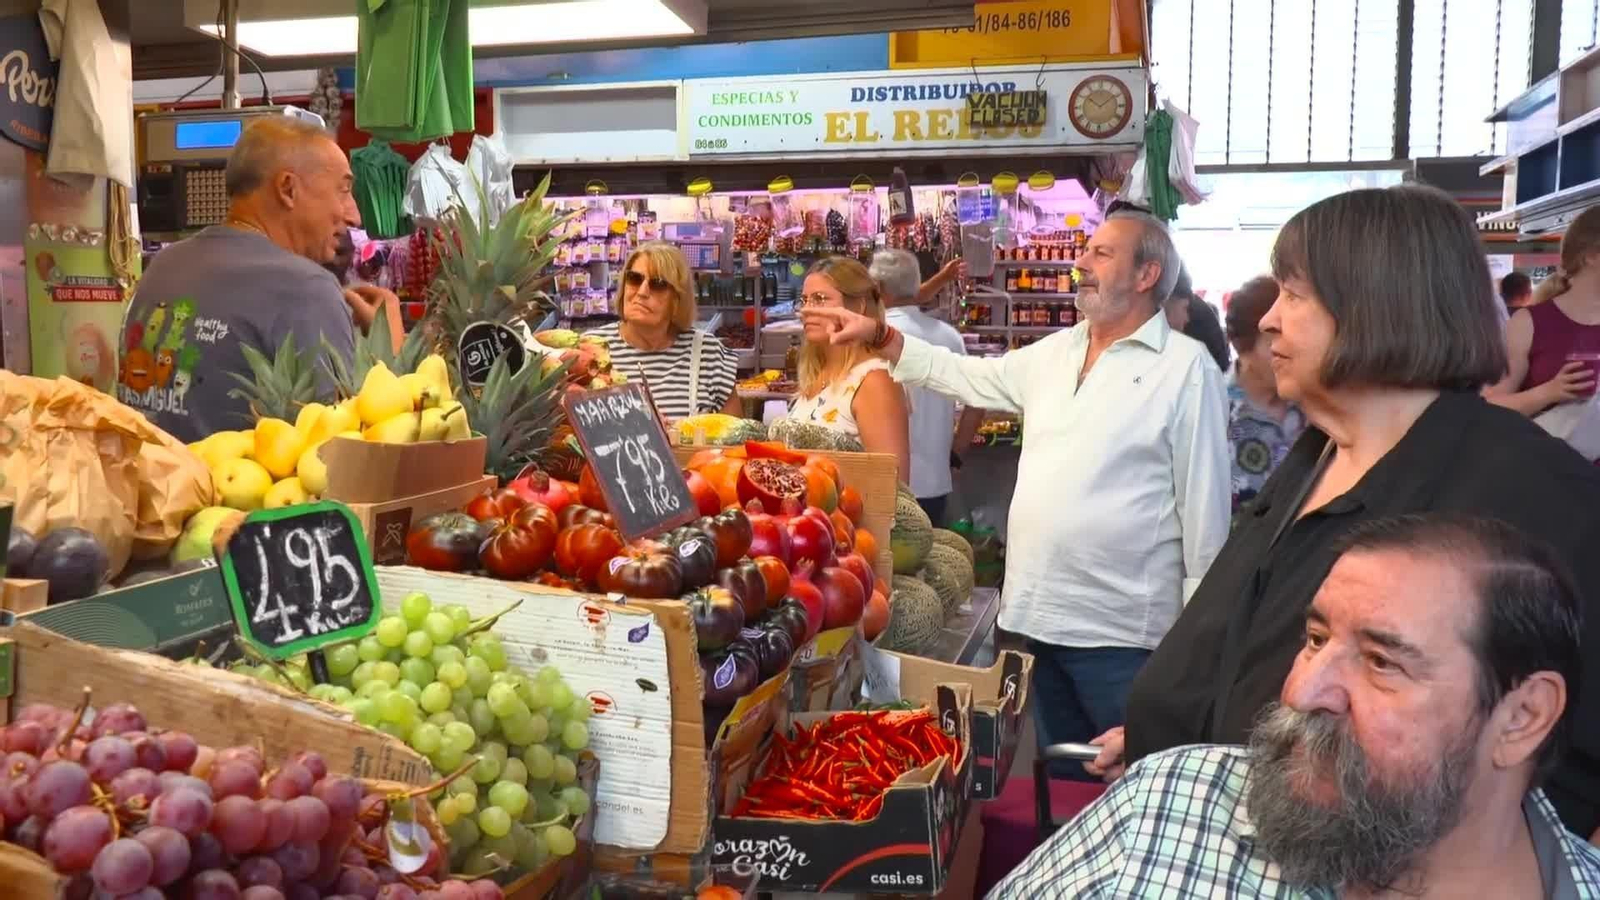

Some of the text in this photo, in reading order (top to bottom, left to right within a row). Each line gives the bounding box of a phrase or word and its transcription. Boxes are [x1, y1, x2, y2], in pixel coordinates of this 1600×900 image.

[943, 10, 1071, 34] 1/84-86/186
[712, 90, 800, 105] ESPECIAS Y
[698, 112, 813, 128] CONDIMENTOS
[823, 111, 880, 143] EL
[55, 288, 118, 301] QUE NOS MUEVE
[141, 384, 189, 416] MIGUEL
[731, 854, 793, 881] Casi
[870, 871, 924, 885] casi.es
